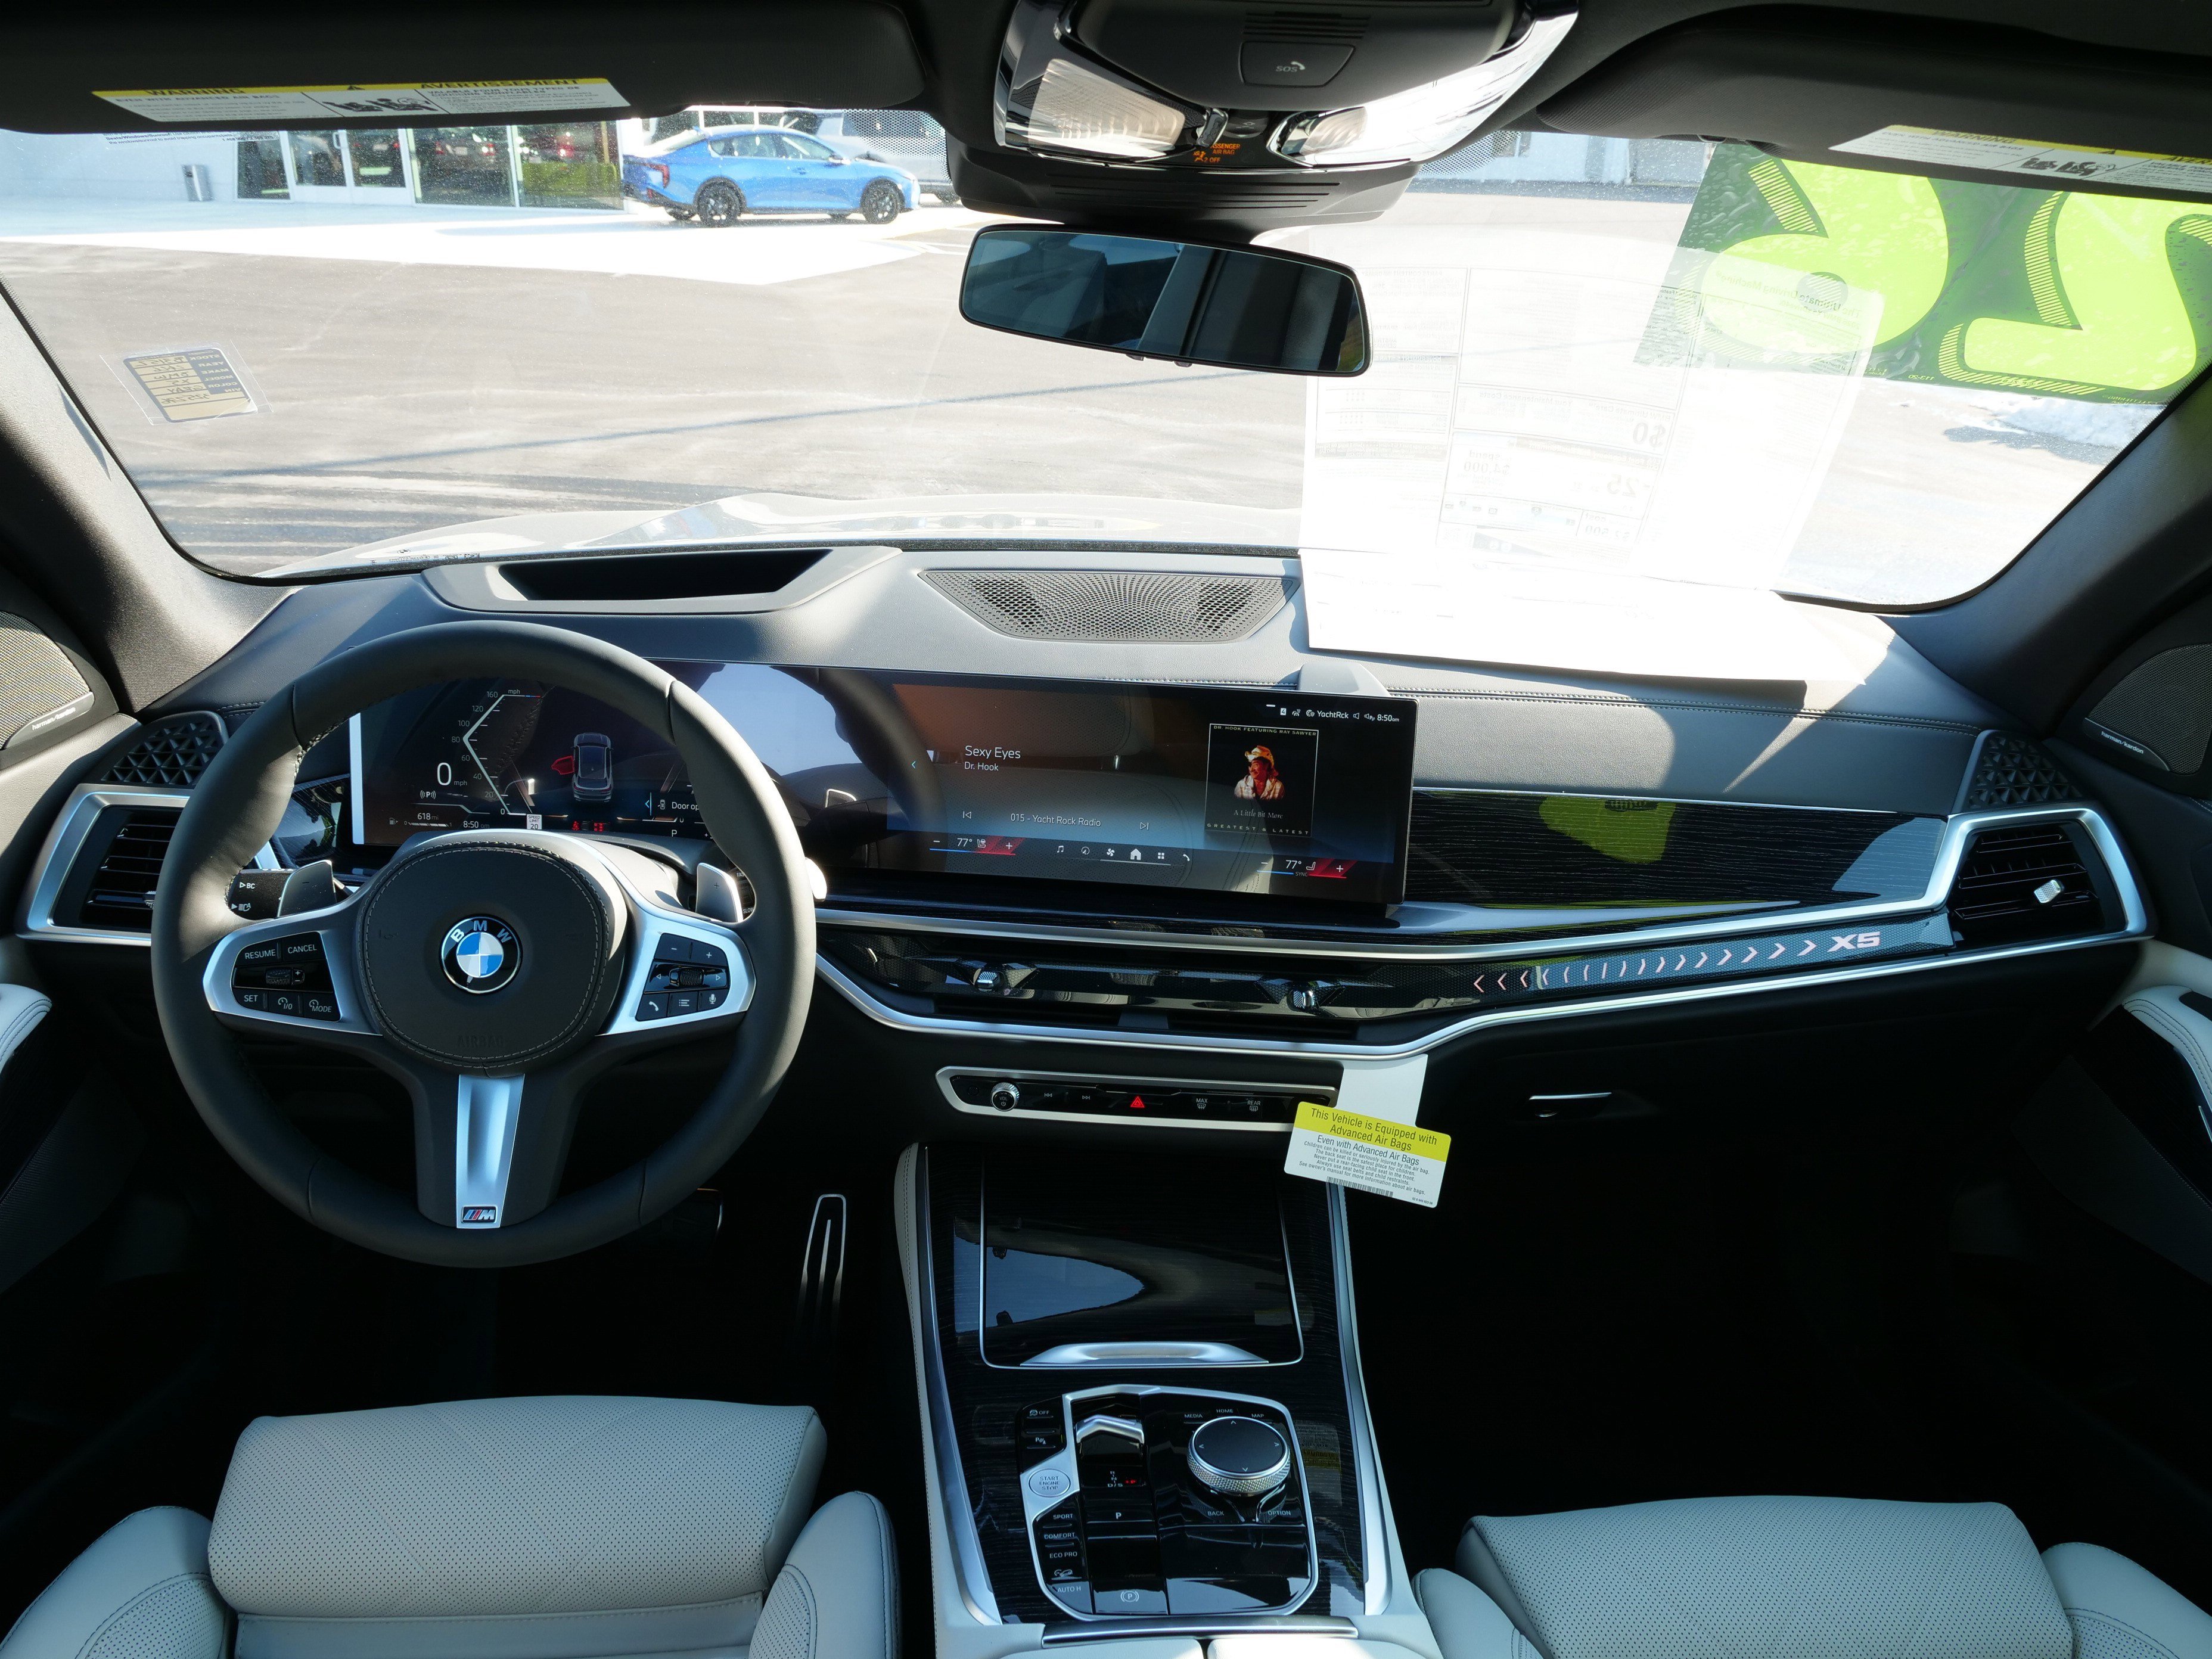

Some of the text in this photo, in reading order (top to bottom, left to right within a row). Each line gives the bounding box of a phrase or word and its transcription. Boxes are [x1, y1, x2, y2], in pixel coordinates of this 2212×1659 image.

[1934, 131, 2016, 144] WARNING
[1317, 710, 1349, 719] YachtRck
[965, 745, 1021, 760] Sexy Eyes
[437, 762, 452, 785] 0
[964, 762, 999, 772] Dr. Hook
[672, 801, 689, 810] Door
[1010, 813, 1101, 827] 015 Yacht Rock Radio
[1240, 809, 1257, 818] Little
[957, 838, 973, 847] 77°
[1285, 860, 1303, 869] 77°
[450, 919, 512, 943] BMW
[1826, 931, 1880, 952] X5
[244, 949, 276, 960] RESUME
[287, 944, 318, 954] CANCEL
[311, 1005, 332, 1013] MODE
[1311, 1108, 1437, 1145] This Vehicle is Equipped with
[1329, 1124, 1412, 1152] Advanced Air Bags
[1317, 1135, 1420, 1166] Even with Advanced Air Bags
[1304, 1141, 1323, 1150] Children
[1339, 1148, 1352, 1156] killed
[1359, 1152, 1380, 1163] seriously
[1380, 1157, 1397, 1166] injured
[1419, 1167, 1430, 1175] bag.
[1360, 1158, 1374, 1166] safest
[1375, 1161, 1388, 1169] place
[1396, 1166, 1416, 1176] children.
[1326, 1167, 1344, 1176] manual
[1364, 1175, 1391, 1186] information
[1391, 1182, 1406, 1190] about
[1413, 1187, 1426, 1195] bags.
[1043, 1531, 1076, 1540] COMFORT
